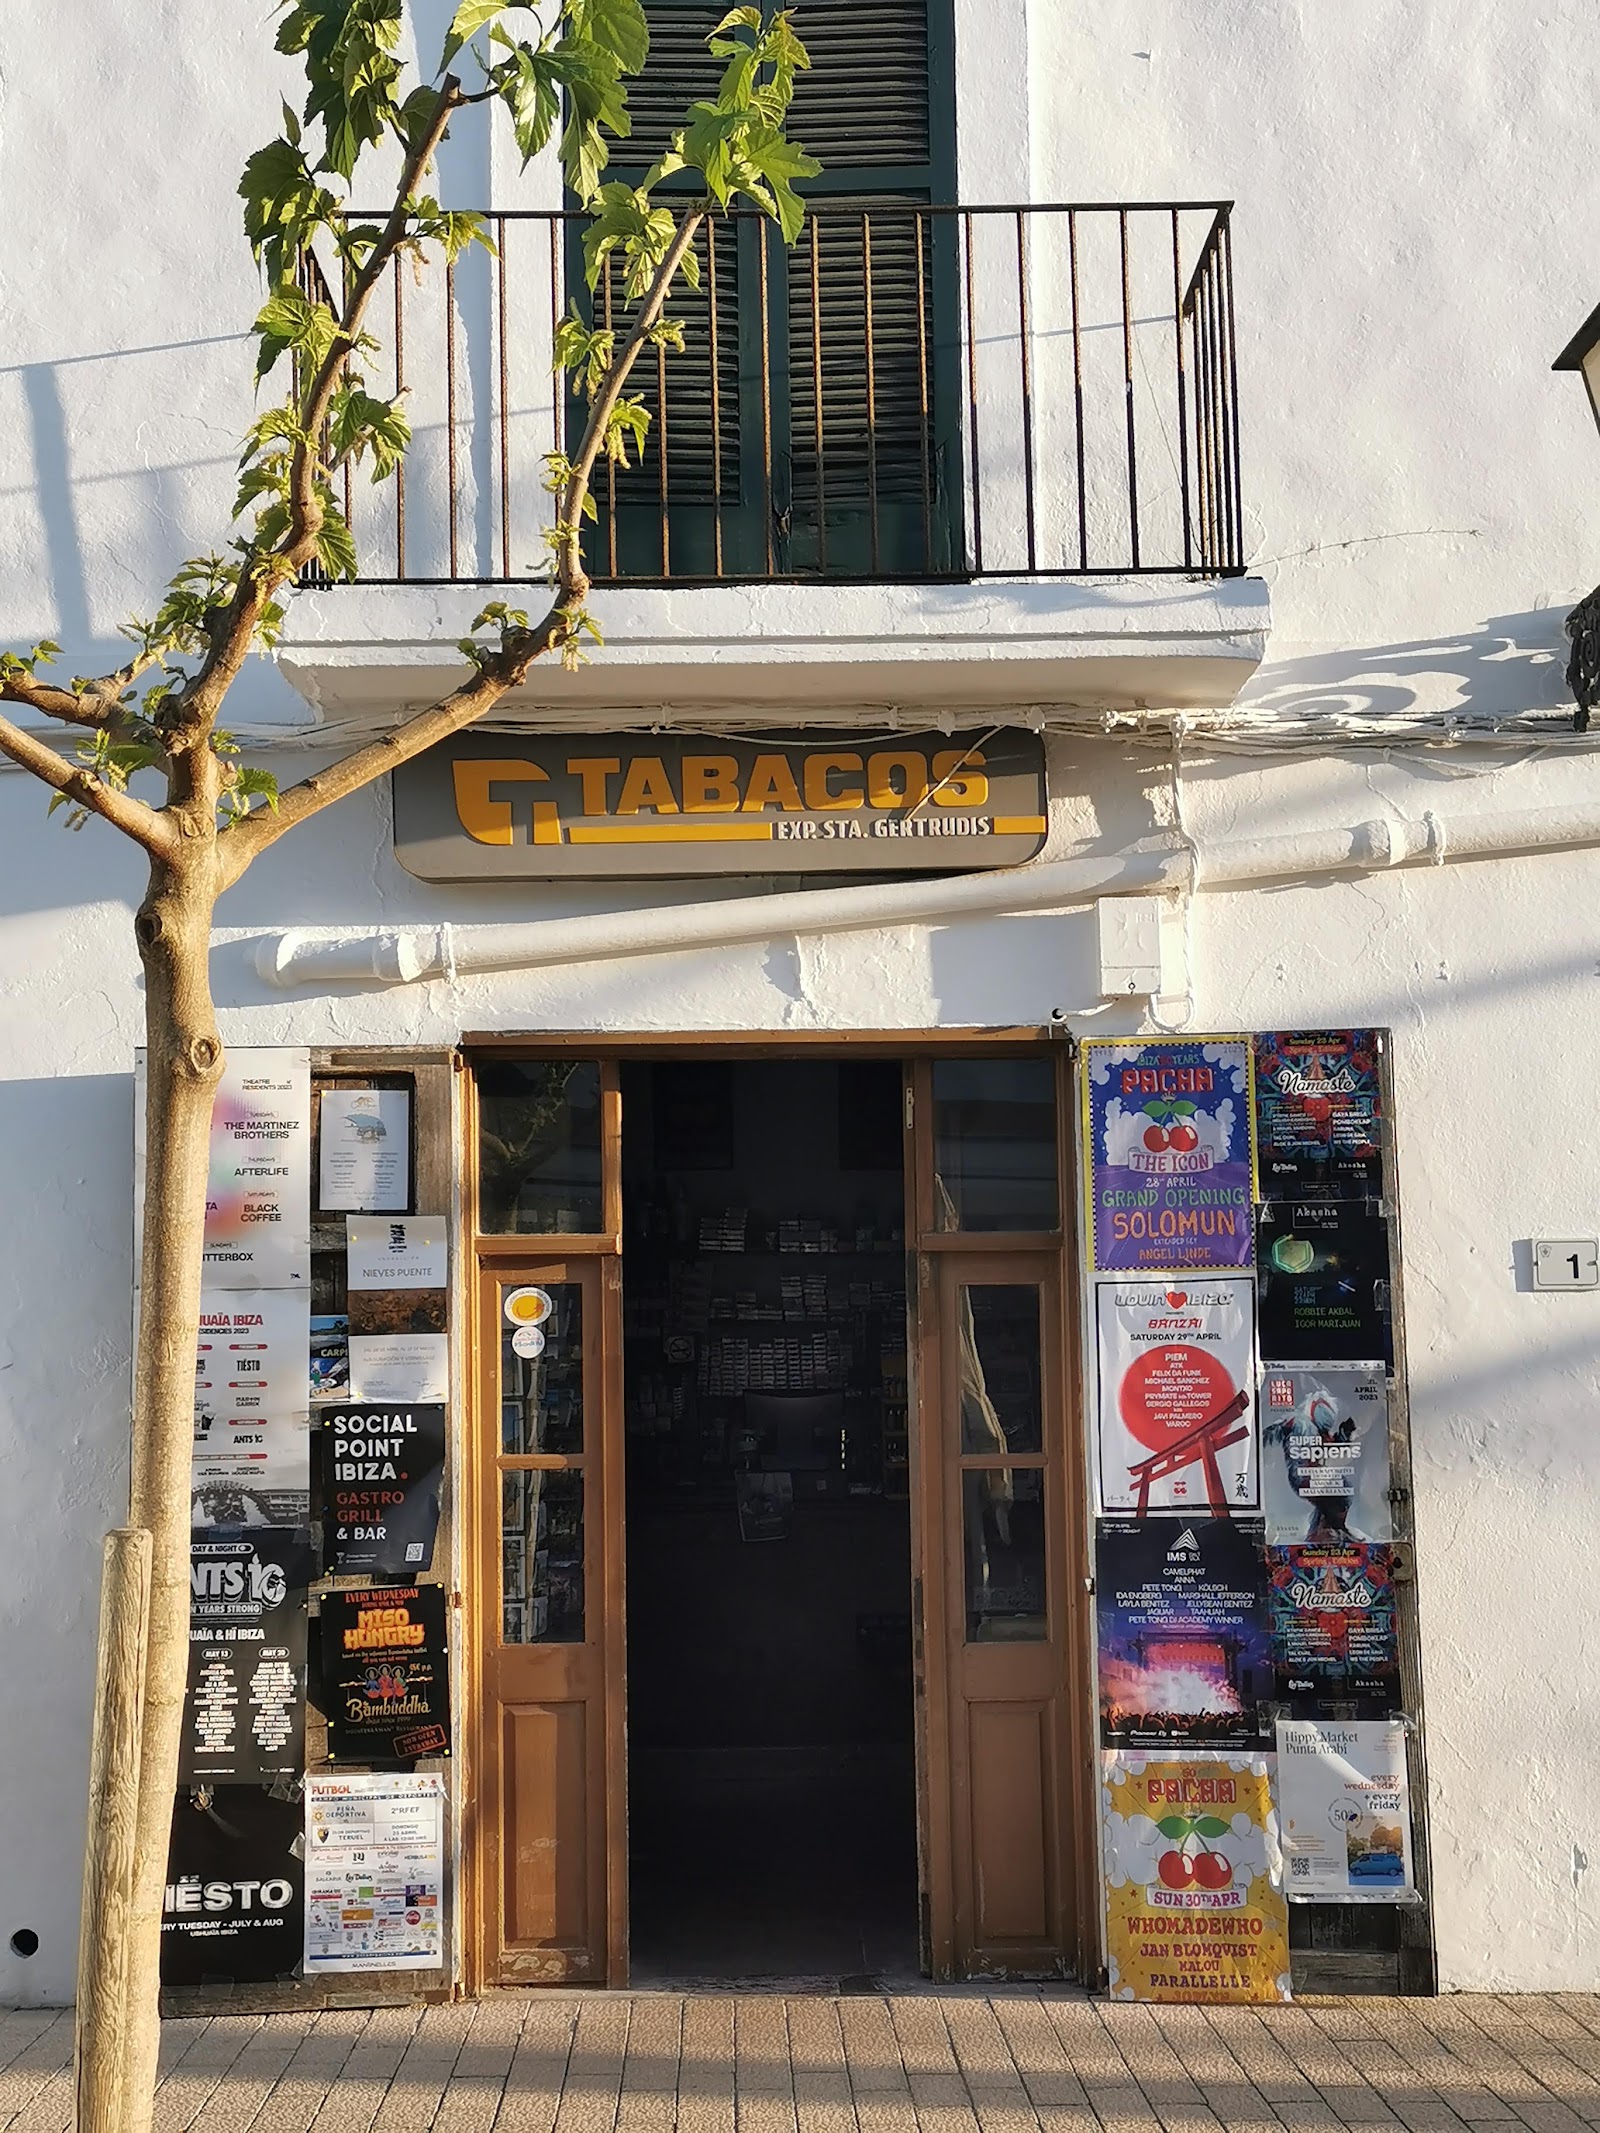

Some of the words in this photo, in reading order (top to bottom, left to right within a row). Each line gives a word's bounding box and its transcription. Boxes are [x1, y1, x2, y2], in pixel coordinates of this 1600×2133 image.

[567, 750, 988, 817] TABACOS
[823, 820, 869, 840] STA.
[874, 817, 991, 839] GERTRUDIS
[1172, 1054, 1200, 1065] YEARS
[1122, 1068, 1214, 1093] PACHA
[1278, 1069, 1356, 1095] Namaste
[224, 1122, 244, 1130] THE
[246, 1121, 299, 1130] MARTINEZ
[234, 1131, 289, 1139] BROTHERS
[1132, 1154, 1167, 1171] THE
[1172, 1153, 1209, 1171] ICON
[234, 1168, 289, 1176] AFTERLIFE
[1167, 1177, 1196, 1187] APRIL
[1102, 1190, 1159, 1207] GRAND
[1165, 1188, 1245, 1207] OPENING
[243, 1204, 279, 1213] BLACK
[1296, 1207, 1338, 1217] Akasha
[240, 1213, 282, 1222] COFFEE
[1114, 1209, 1235, 1240] SOLOMUN
[1139, 1249, 1175, 1260] ANGEL
[1178, 1248, 1211, 1259] LINDE
[1566, 1253, 1579, 1279] 1
[363, 1268, 396, 1278] NIEVES
[397, 1267, 433, 1277] PUENTE
[1294, 1307, 1326, 1316] ROBBIE
[1328, 1307, 1355, 1316] AKBAL
[200, 1312, 231, 1326] UAÏA
[233, 1314, 264, 1326] IBIZA
[1148, 1318, 1203, 1329] BANZAI
[1295, 1320, 1316, 1328] IGOR
[1318, 1320, 1360, 1328] MARIJUAN
[1165, 1353, 1187, 1361] PIEM
[334, 1414, 418, 1434] SOCIAL
[233, 1435, 253, 1444] ANTS
[1290, 1436, 1322, 1446] SUPER
[335, 1439, 404, 1458] POINT
[1290, 1445, 1361, 1462] sapiens
[336, 1491, 405, 1505] GASTRO
[337, 1509, 384, 1523] GRILL
[336, 1527, 348, 1540] &
[354, 1527, 387, 1540] BAR
[192, 1545, 206, 1553] DAY
[1303, 1549, 1329, 1557] Sunday
[1167, 1552, 1186, 1561] IMS
[190, 1562, 244, 1597] NTS
[345, 1591, 370, 1604] EVERY
[371, 1587, 419, 1600] WEDNESDAY
[1292, 1582, 1372, 1609] Namaste
[199, 1605, 225, 1613] YEARS
[227, 1604, 260, 1613] STRONG
[358, 1608, 410, 1630] MISO
[1178, 1616, 1214, 1624] ACADEMY
[190, 1627, 213, 1640] UAÏA
[215, 1630, 223, 1640] &
[238, 1629, 265, 1639] IBIZA
[344, 1623, 425, 1650] HUNGRY
[344, 1695, 431, 1722] Bambuddha
[1285, 1732, 1318, 1744] Hippy
[1320, 1731, 1358, 1742] Market
[1286, 1743, 1316, 1754] Punta
[1319, 1742, 1347, 1754] Arabí
[1371, 1774, 1399, 1783] every
[312, 1785, 351, 1795] FUTBOL
[1147, 1778, 1236, 1804] PACHA
[1344, 1782, 1399, 1791] wednesday
[1372, 1793, 1400, 1801] every
[337, 1804, 355, 1812] PEÑA
[1369, 1801, 1400, 1810] friday
[165, 1875, 293, 1912] IËSTO
[1154, 1892, 1183, 1906] SUN
[1211, 1892, 1241, 1906] APR
[178, 1921, 221, 1930] TUESDAY
[228, 1920, 252, 1928] JULY
[254, 1919, 261, 1927] &
[263, 1918, 283, 1926] AUG
[1127, 1917, 1263, 1936] WHOMADEWHO
[1140, 1943, 1169, 1958] JAN
[1173, 1943, 1257, 1959] BLOMQVIST
[1179, 1960, 1220, 1972] MALOU
